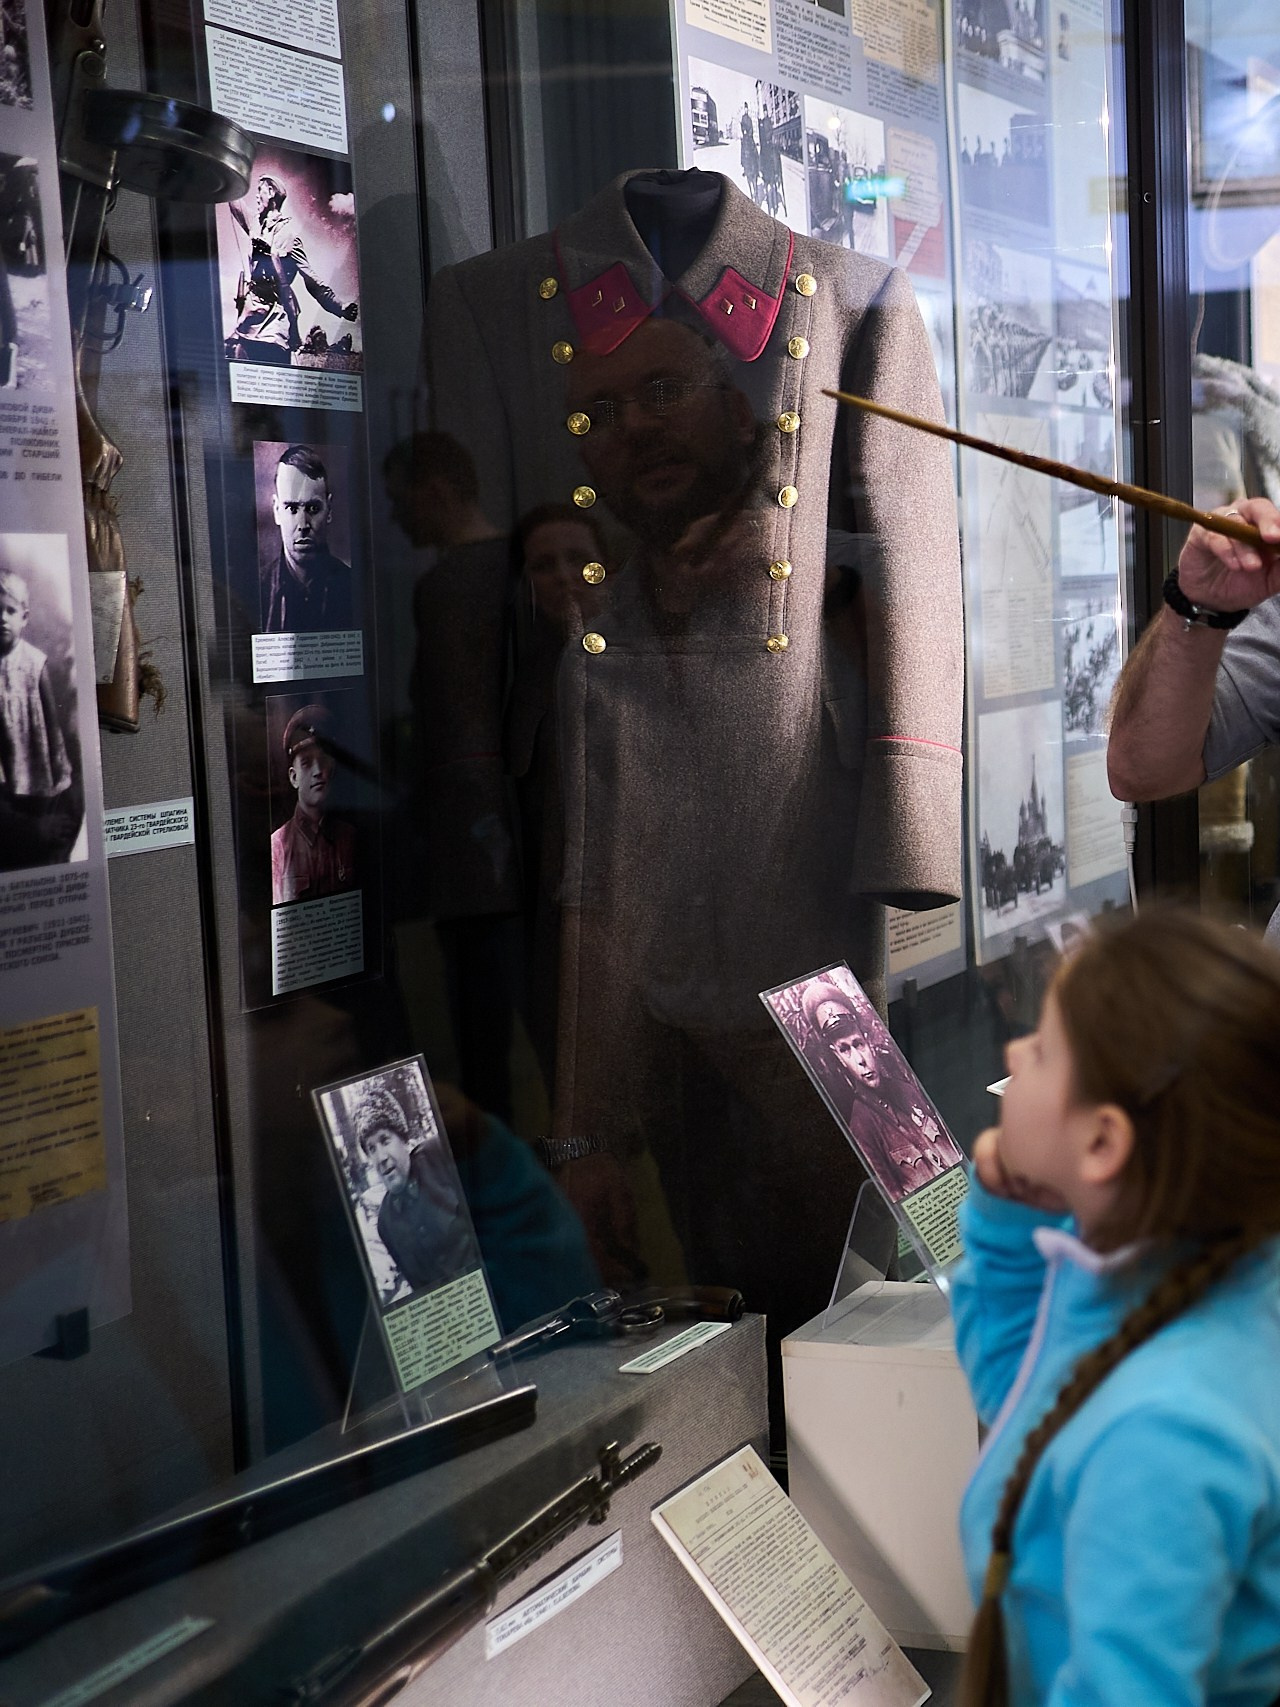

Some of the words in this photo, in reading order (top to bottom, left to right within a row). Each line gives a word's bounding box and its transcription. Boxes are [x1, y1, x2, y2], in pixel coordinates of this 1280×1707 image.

[129, 813, 156, 822] СИСТЕМЫ
[160, 808, 187, 818] ШПАГИНА
[130, 823, 145, 831] 23-го
[146, 816, 188, 828] ГВАРДЕЙСКОГО
[110, 829, 150, 841] ГВАРДЕЙСКОЙ
[152, 823, 189, 835] СТРЕЛКОВОЙ
